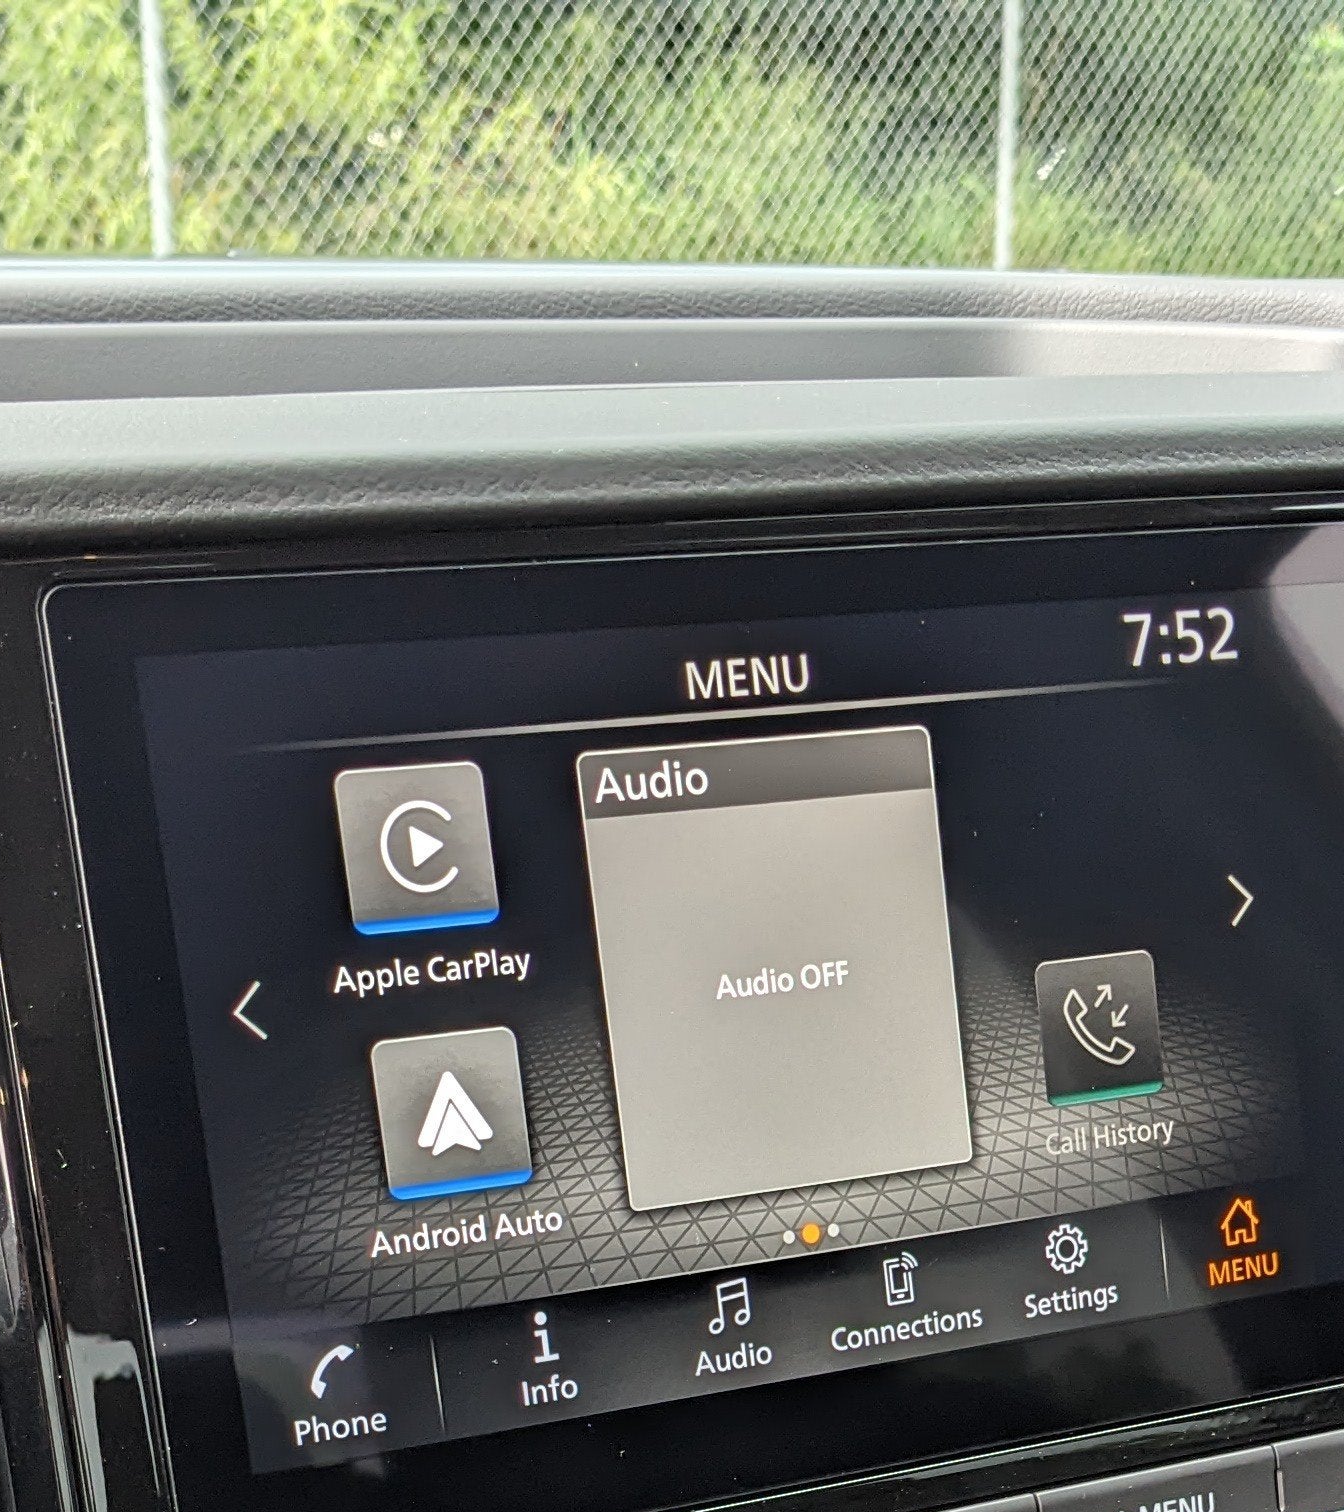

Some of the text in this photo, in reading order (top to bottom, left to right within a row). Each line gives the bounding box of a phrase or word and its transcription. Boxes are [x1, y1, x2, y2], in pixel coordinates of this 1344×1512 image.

[1121, 607, 1240, 668] 7:52
[685, 653, 811, 700] MENU
[595, 760, 709, 805] Audio
[333, 948, 532, 997] Apple CarPlay
[716, 960, 849, 1001] Audio OFF
[1045, 1117, 1175, 1157] Call History
[370, 1207, 563, 1258] Android Auto
[1208, 1251, 1279, 1287] MENU
[1023, 1281, 1118, 1321] Settings
[830, 1303, 983, 1355] Connections
[694, 1339, 773, 1379] Audio
[521, 1373, 578, 1407] Info
[292, 1409, 388, 1448] Phone
